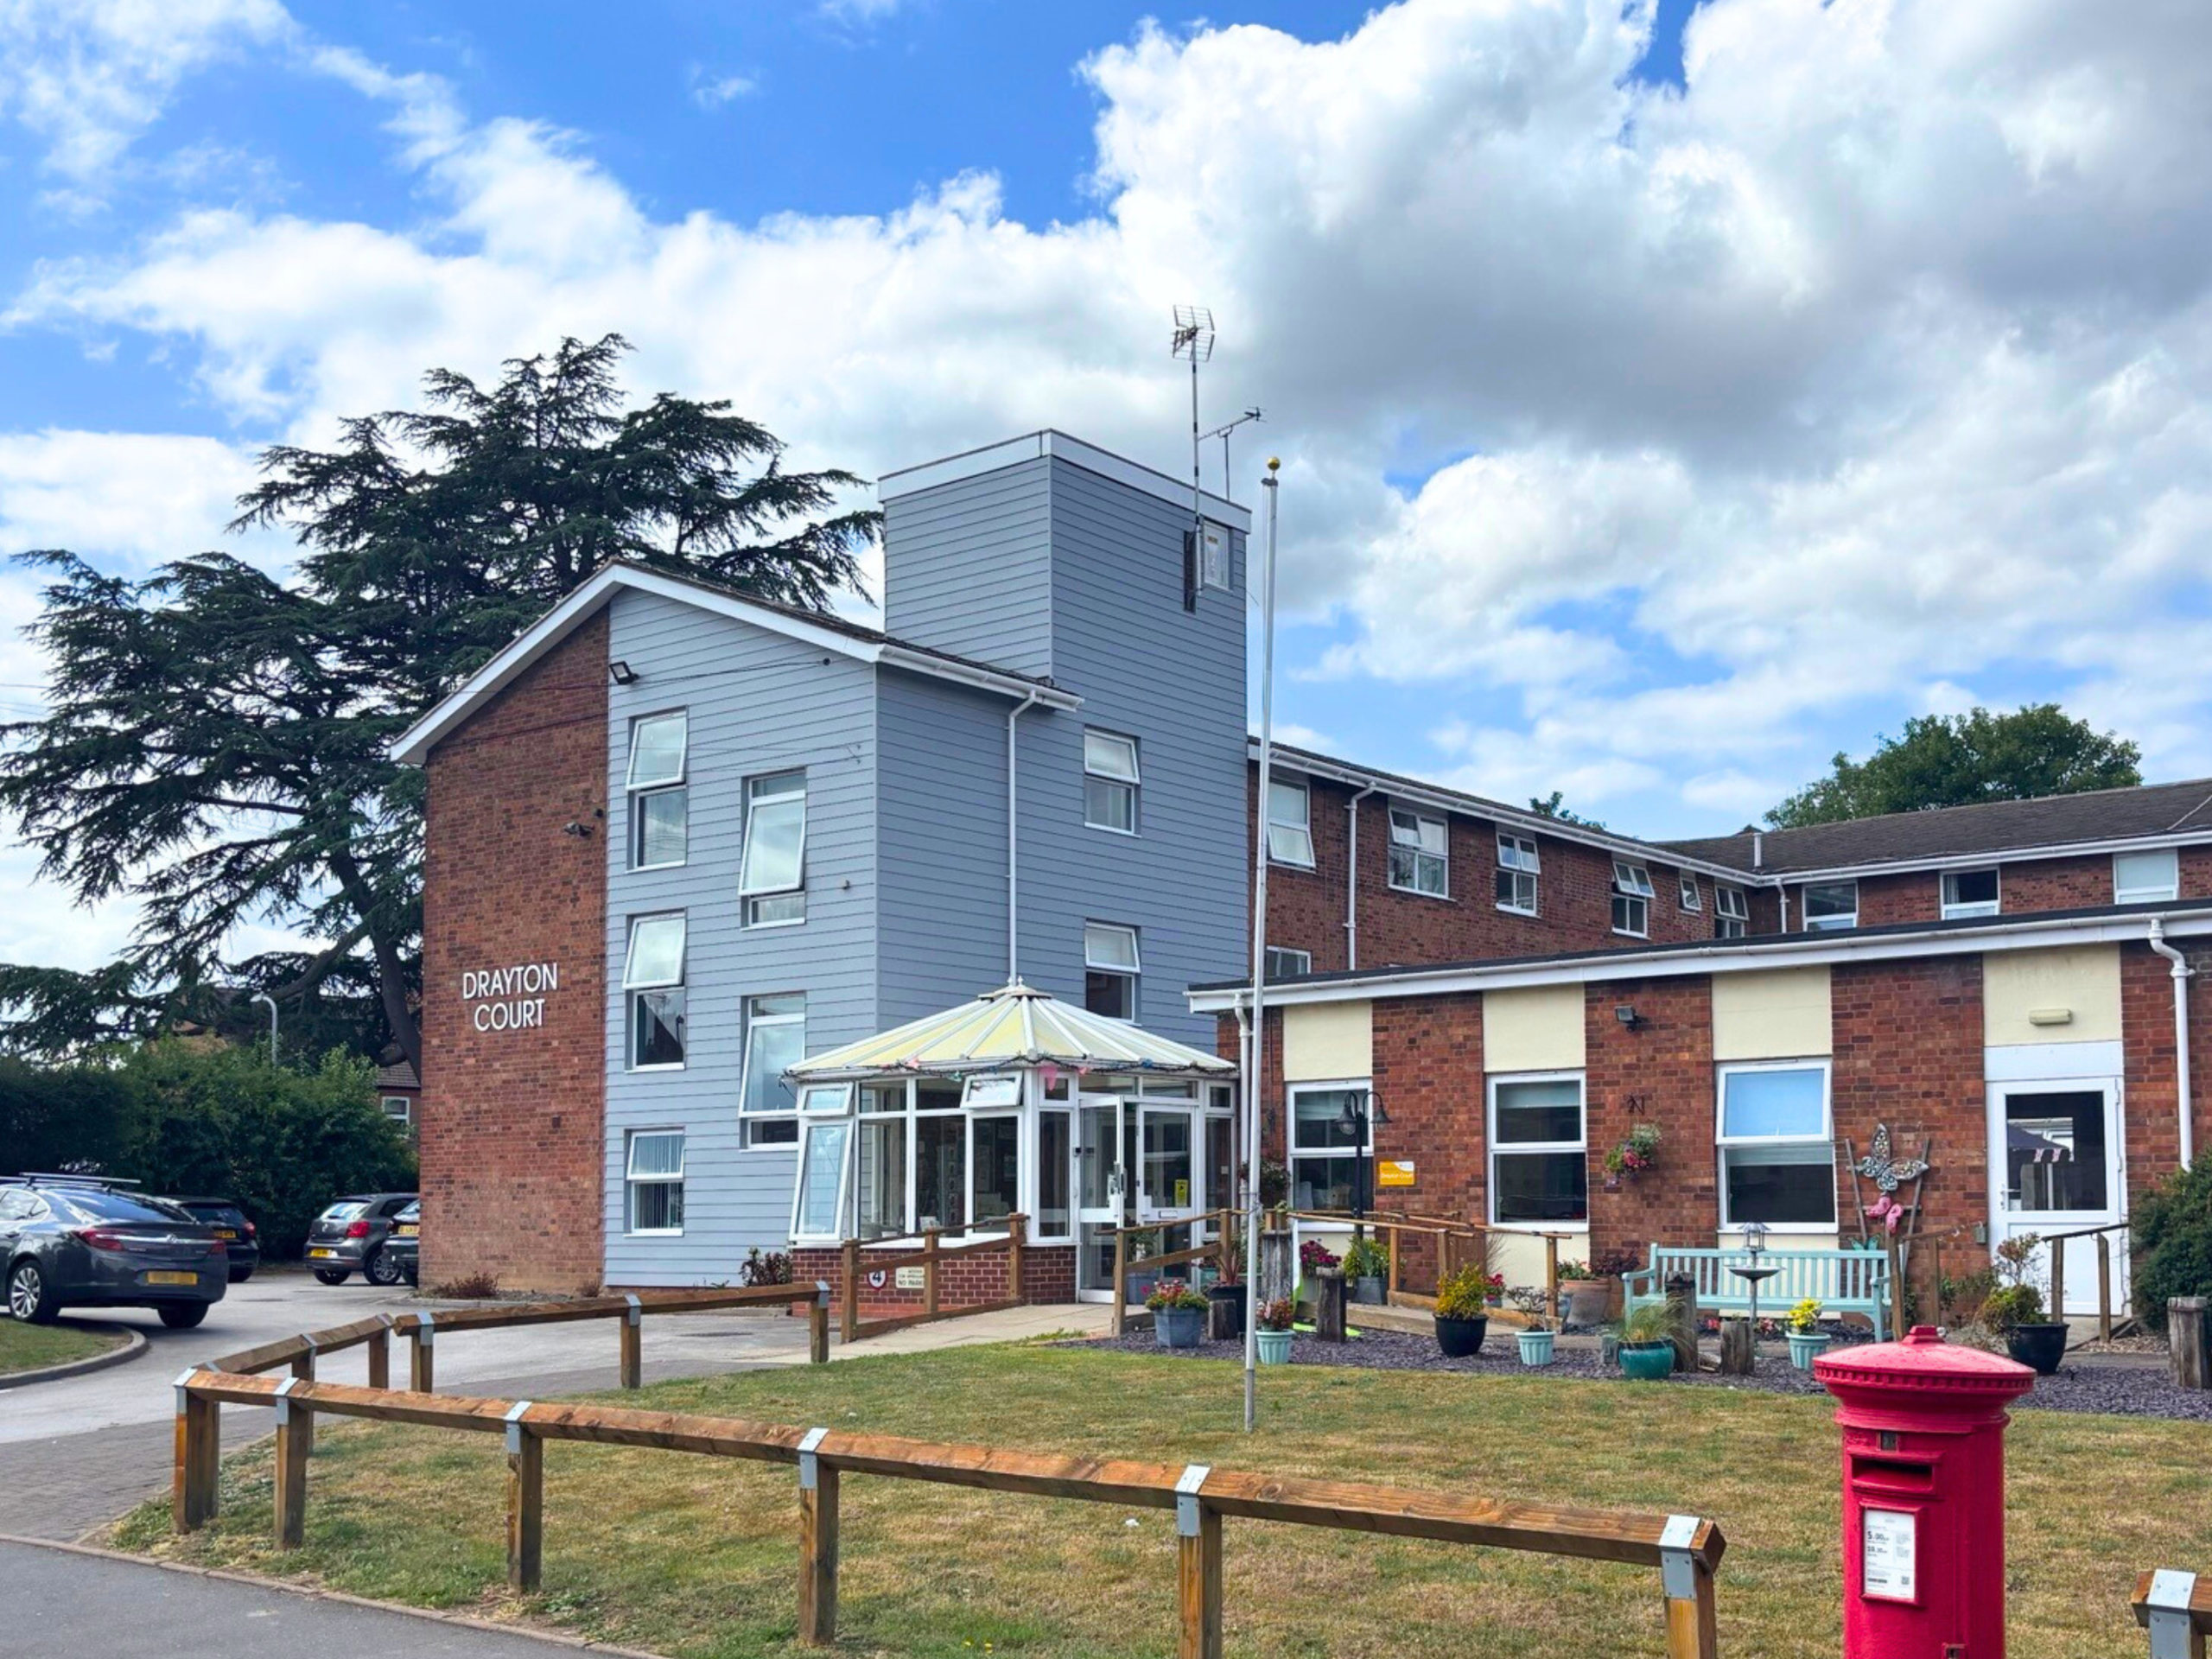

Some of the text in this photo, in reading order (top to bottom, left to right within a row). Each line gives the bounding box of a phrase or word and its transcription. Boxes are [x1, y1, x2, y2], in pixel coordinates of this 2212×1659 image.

[462, 963, 558, 1000] DRAYTON
[474, 998, 545, 1032] COURT
[872, 1270, 882, 1283] 4
